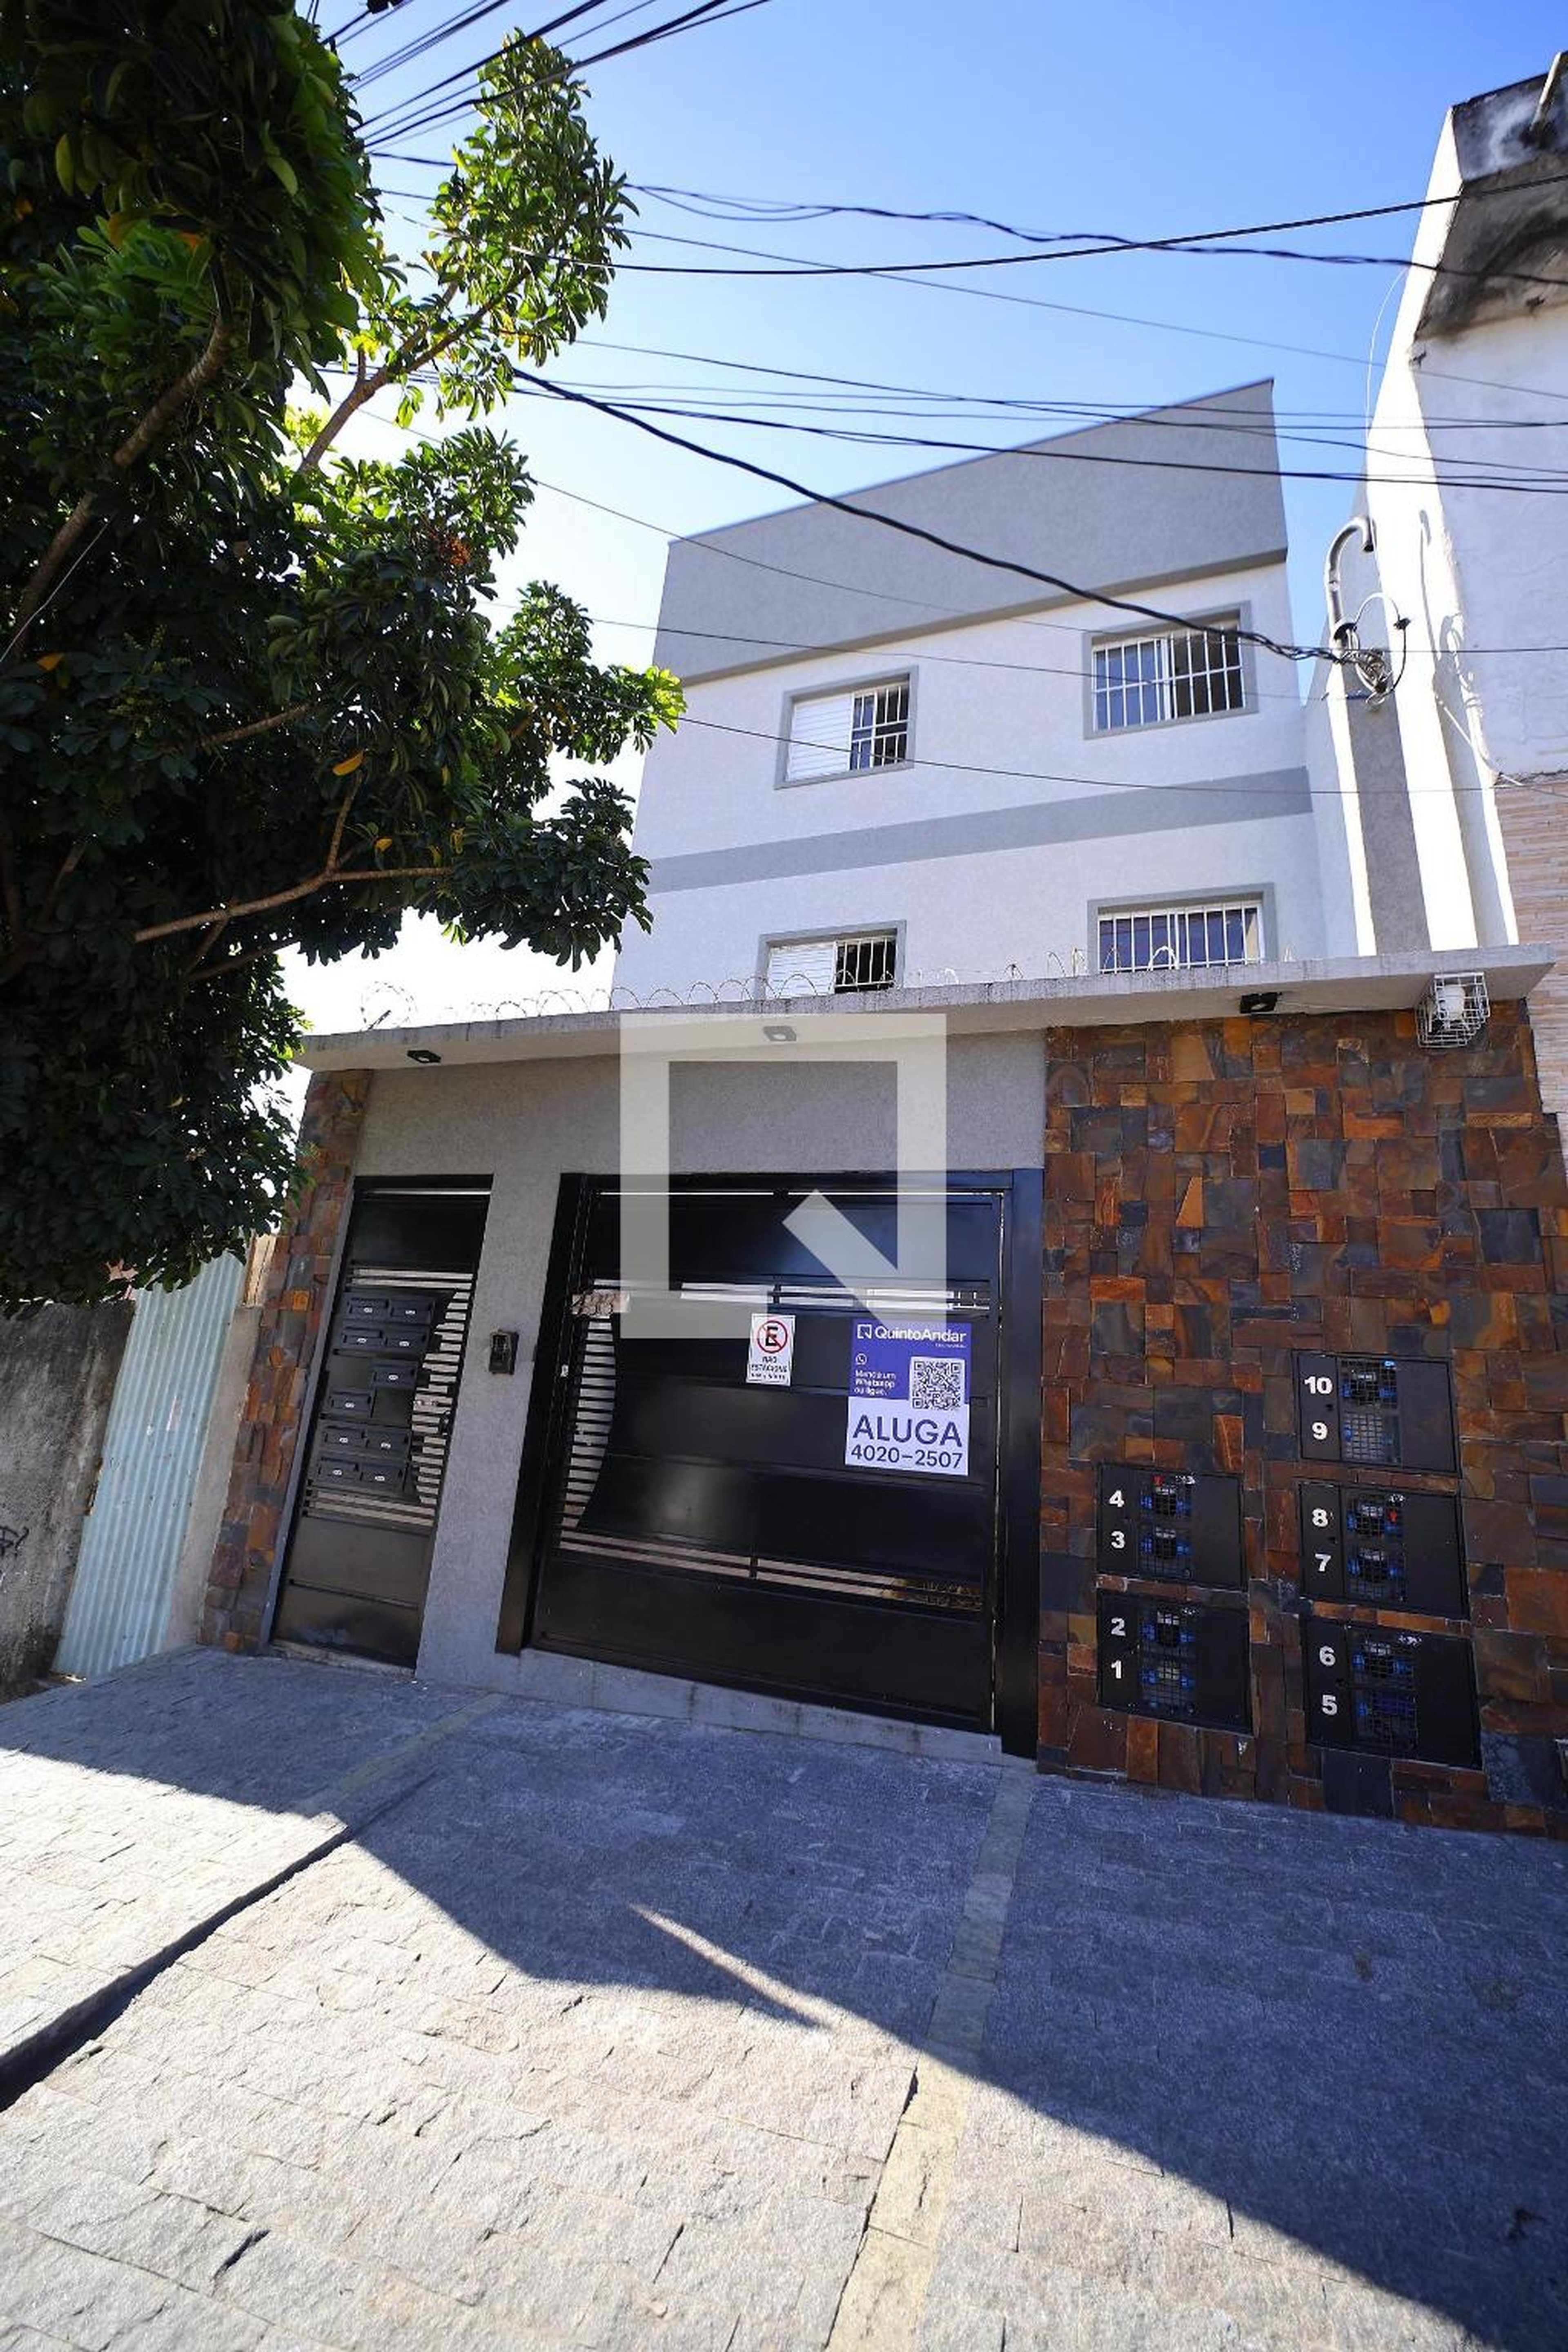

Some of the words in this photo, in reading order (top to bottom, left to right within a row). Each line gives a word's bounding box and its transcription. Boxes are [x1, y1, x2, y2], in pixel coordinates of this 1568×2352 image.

[875, 1326, 967, 1342] QuintoAndar
[1304, 1376, 1333, 1394] 10
[853, 1414, 962, 1447] ALUGA
[1312, 1422, 1328, 1440] 9
[851, 1444, 962, 1468] 4020-2507
[1109, 1490, 1125, 1508] 4
[1312, 1508, 1328, 1527] 8
[1111, 1530, 1125, 1549] 3
[1314, 1553, 1332, 1572] 7
[1111, 1617, 1126, 1636] 2
[1319, 1645, 1336, 1666] 6
[1111, 1660, 1122, 1679] 1
[1322, 1695, 1338, 1715] 5
